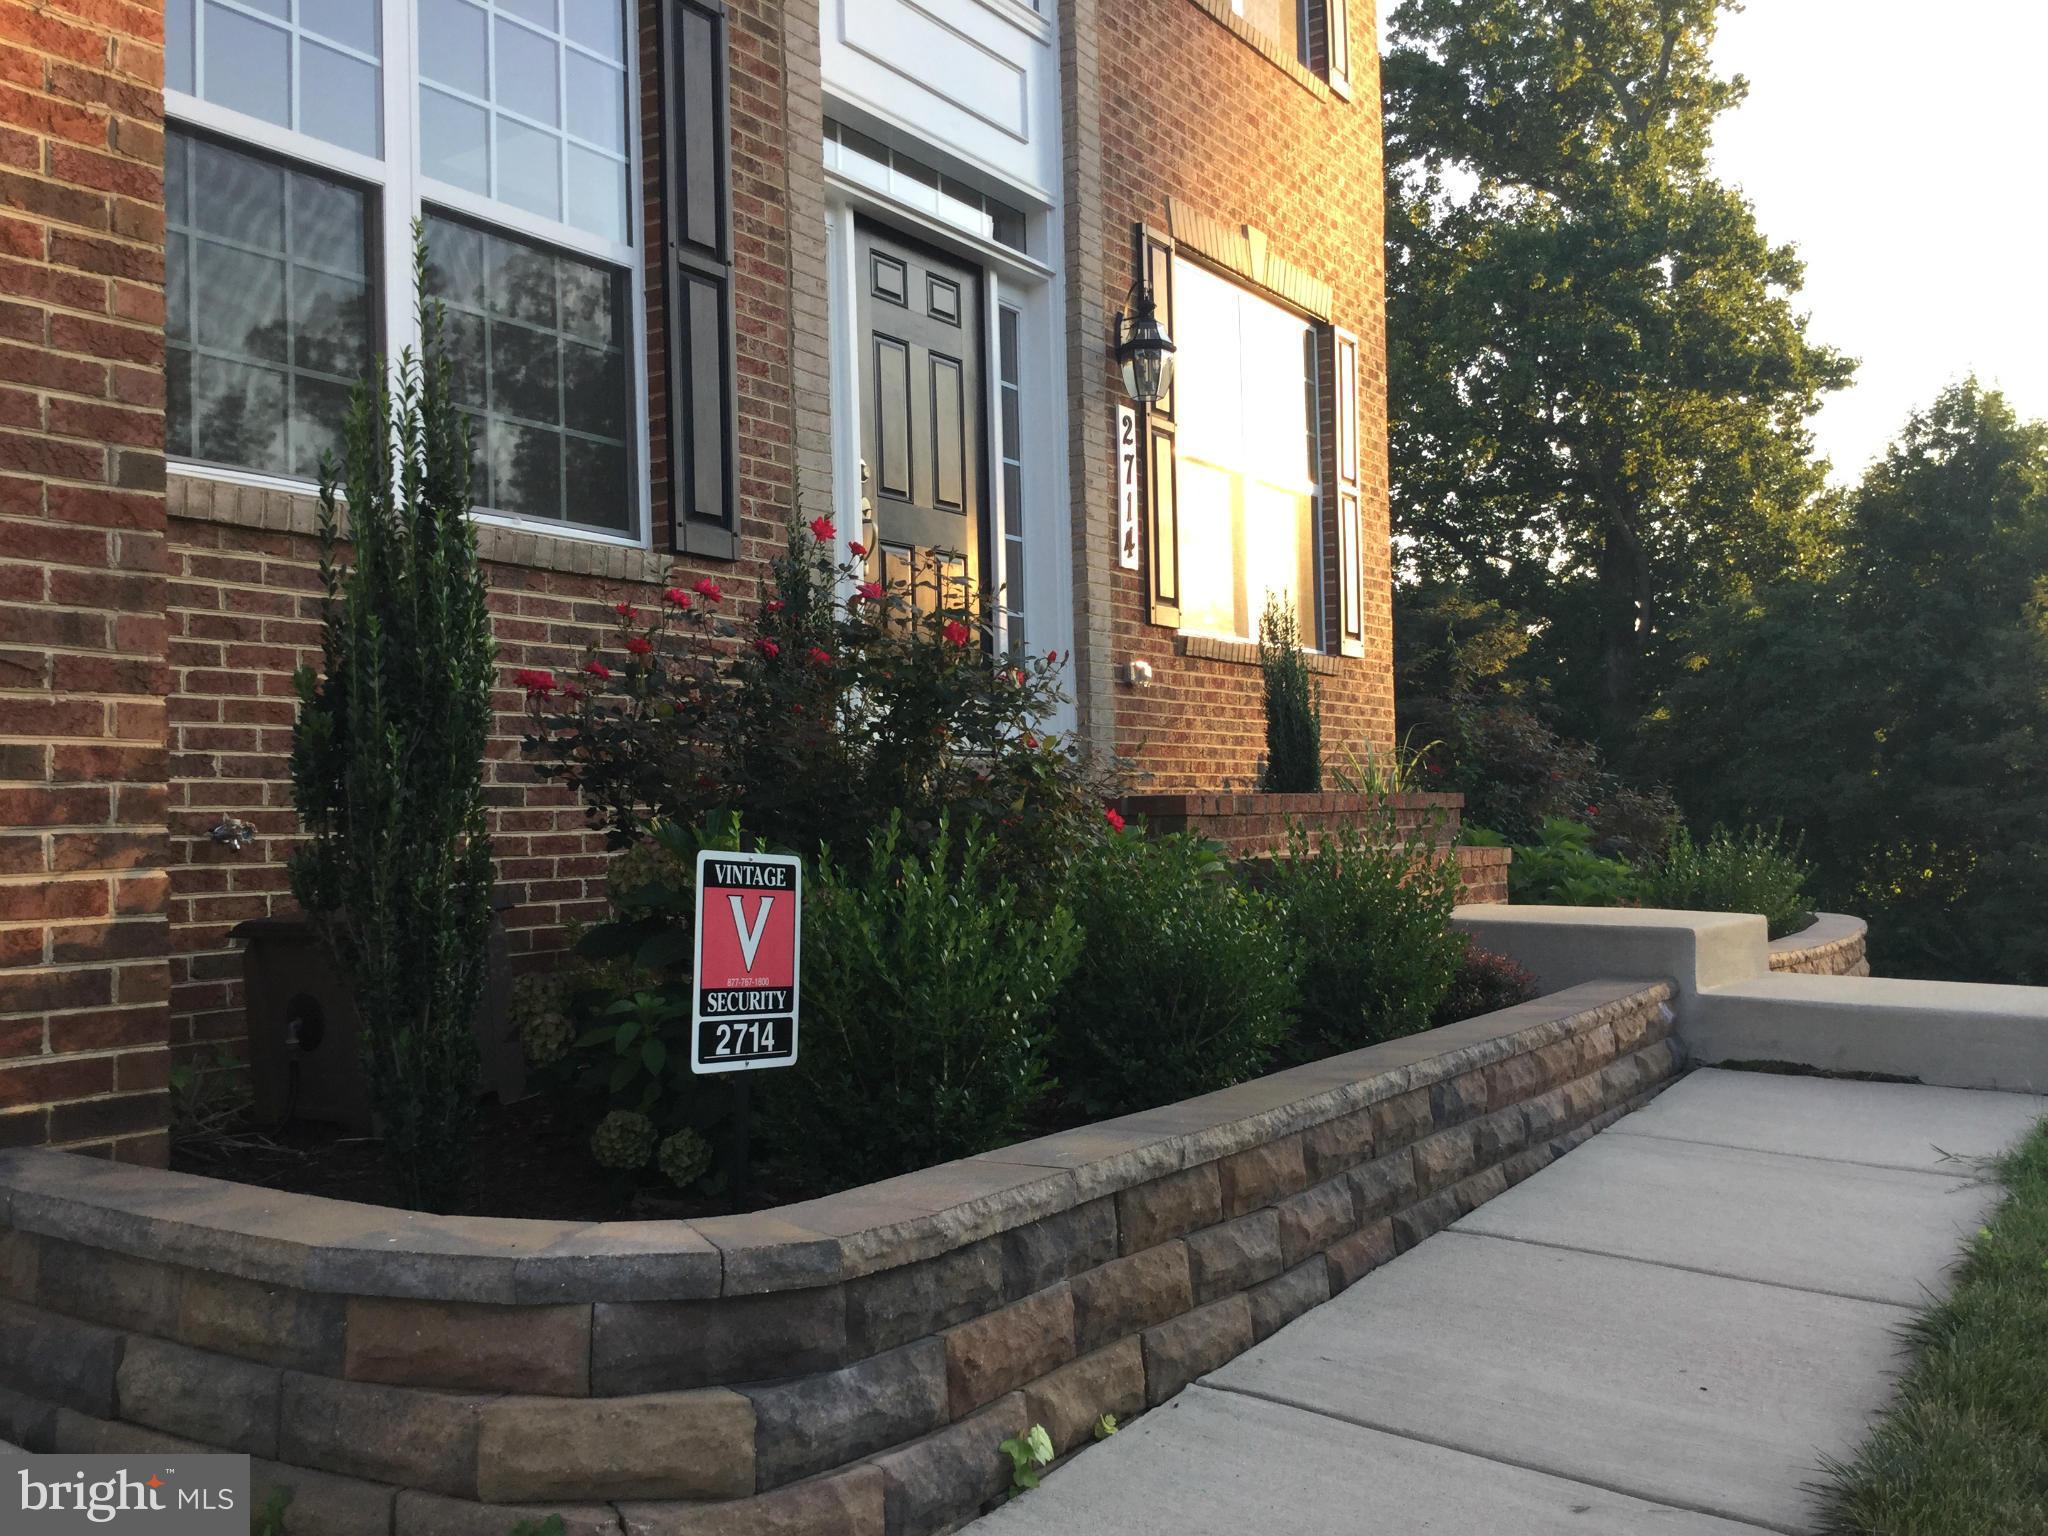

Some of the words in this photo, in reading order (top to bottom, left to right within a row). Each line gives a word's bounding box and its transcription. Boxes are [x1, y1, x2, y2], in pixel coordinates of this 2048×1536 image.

[1122, 415, 1135, 558] 2714
[715, 864, 786, 887] VINTAGE
[726, 895, 775, 974] V
[707, 991, 787, 1013] SECURITY
[716, 1022, 775, 1055] 2714
